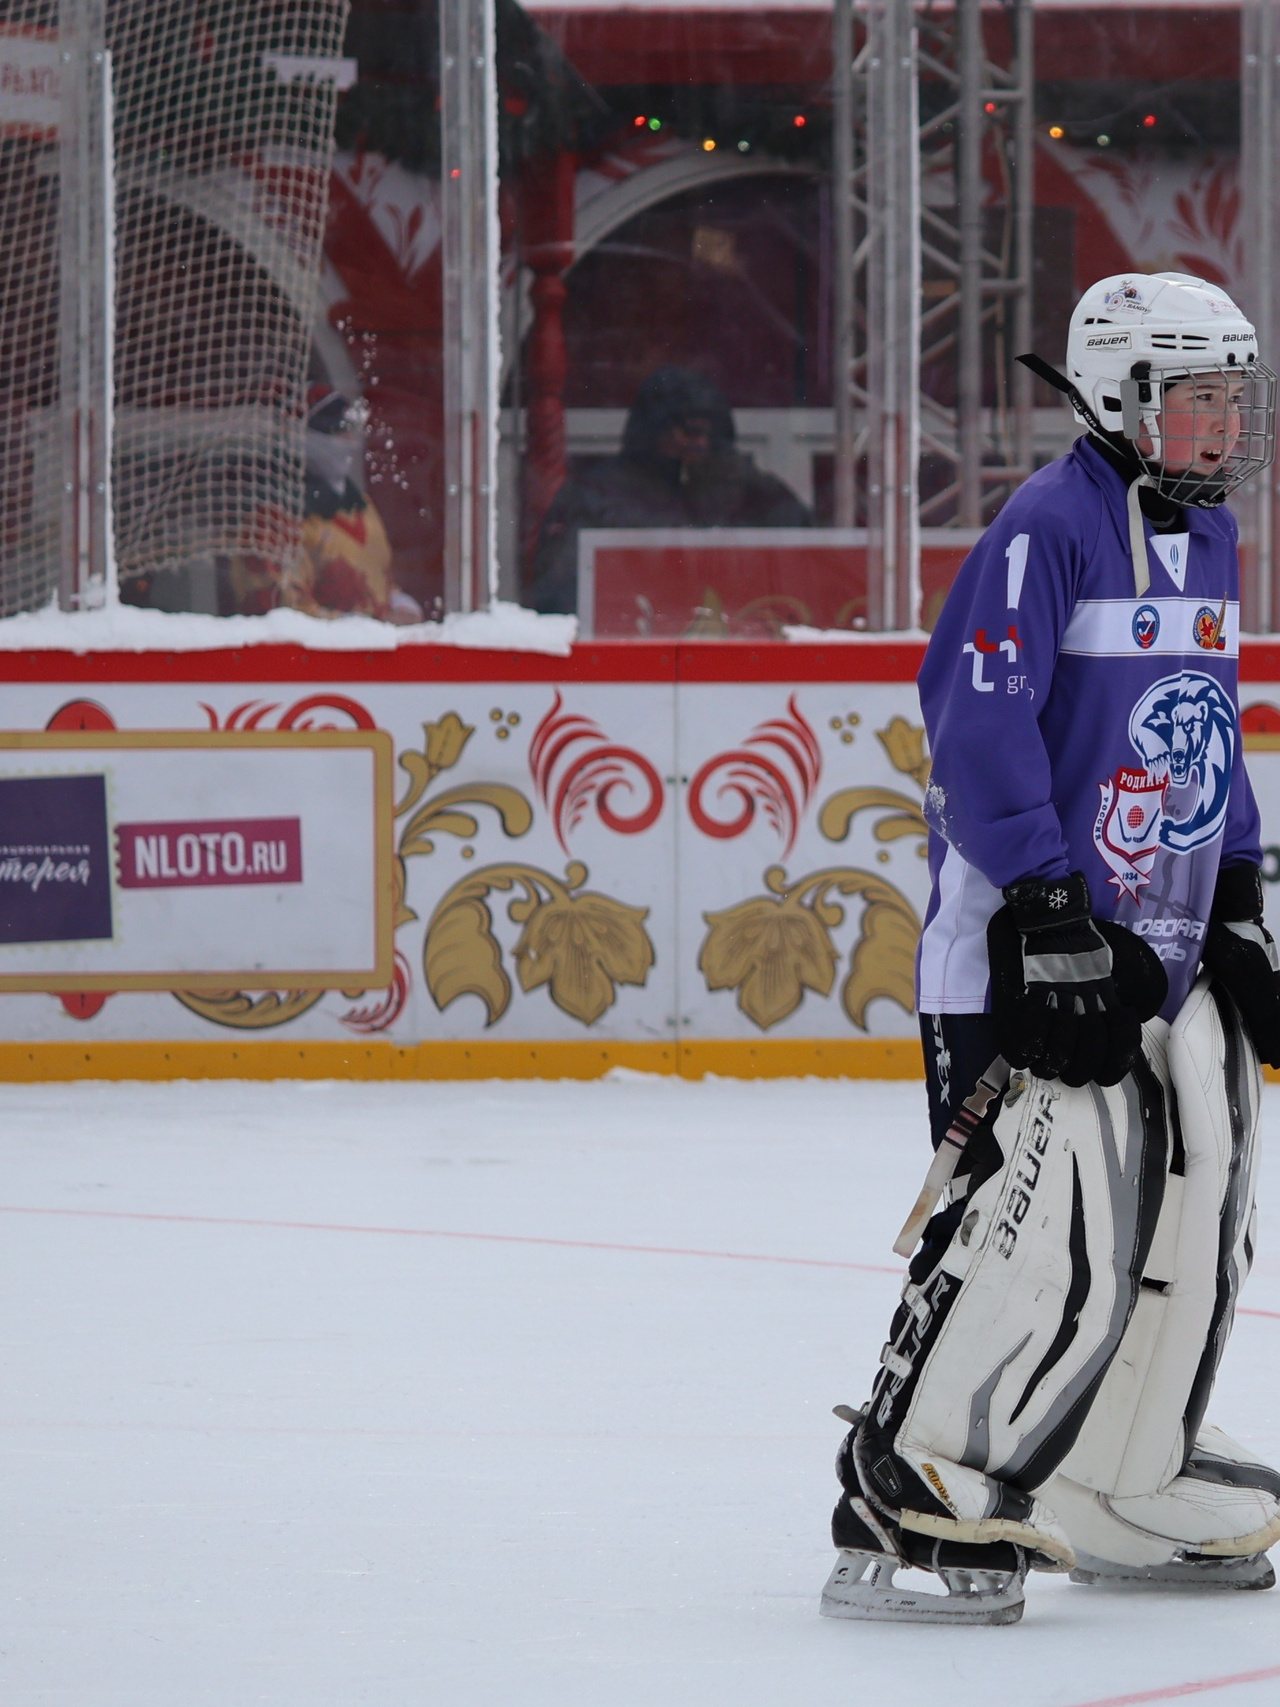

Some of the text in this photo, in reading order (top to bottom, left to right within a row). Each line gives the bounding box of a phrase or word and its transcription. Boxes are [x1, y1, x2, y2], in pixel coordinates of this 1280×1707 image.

[1086, 336, 1130, 347] BAUER
[1222, 332, 1255, 343] BAUER
[1119, 771, 1165, 791] РОДИНА
[1095, 796, 1109, 841] РОССИЯ
[0, 844, 91, 856] АЦИОНАЛЬНАЯ
[134, 831, 288, 879] NLOTO.RU
[1122, 871, 1139, 881] 1934
[992, 1082, 1061, 1261] BAUER
